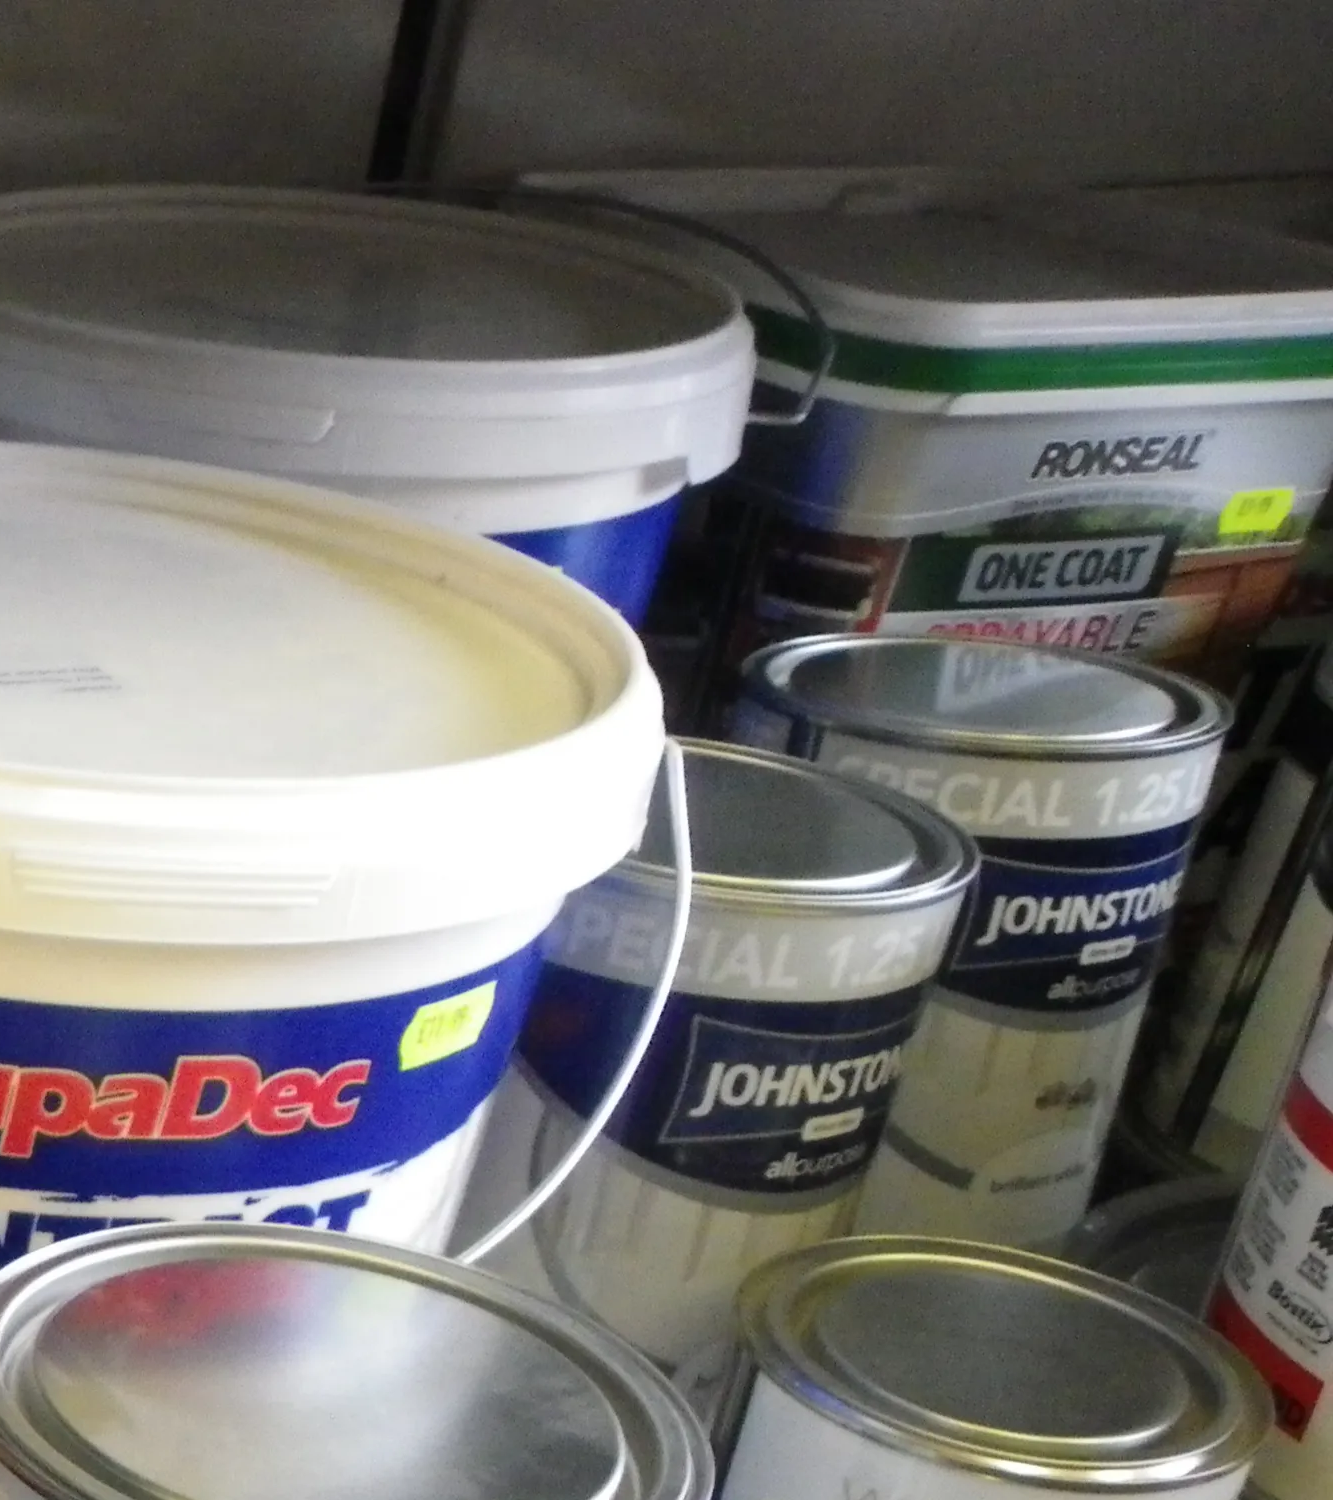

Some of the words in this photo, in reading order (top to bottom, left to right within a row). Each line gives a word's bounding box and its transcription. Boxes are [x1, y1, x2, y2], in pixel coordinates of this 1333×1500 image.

[1030, 434, 1204, 480] RONSEAL
[975, 548, 1049, 592] ONE
[1055, 543, 1150, 588] COAT
